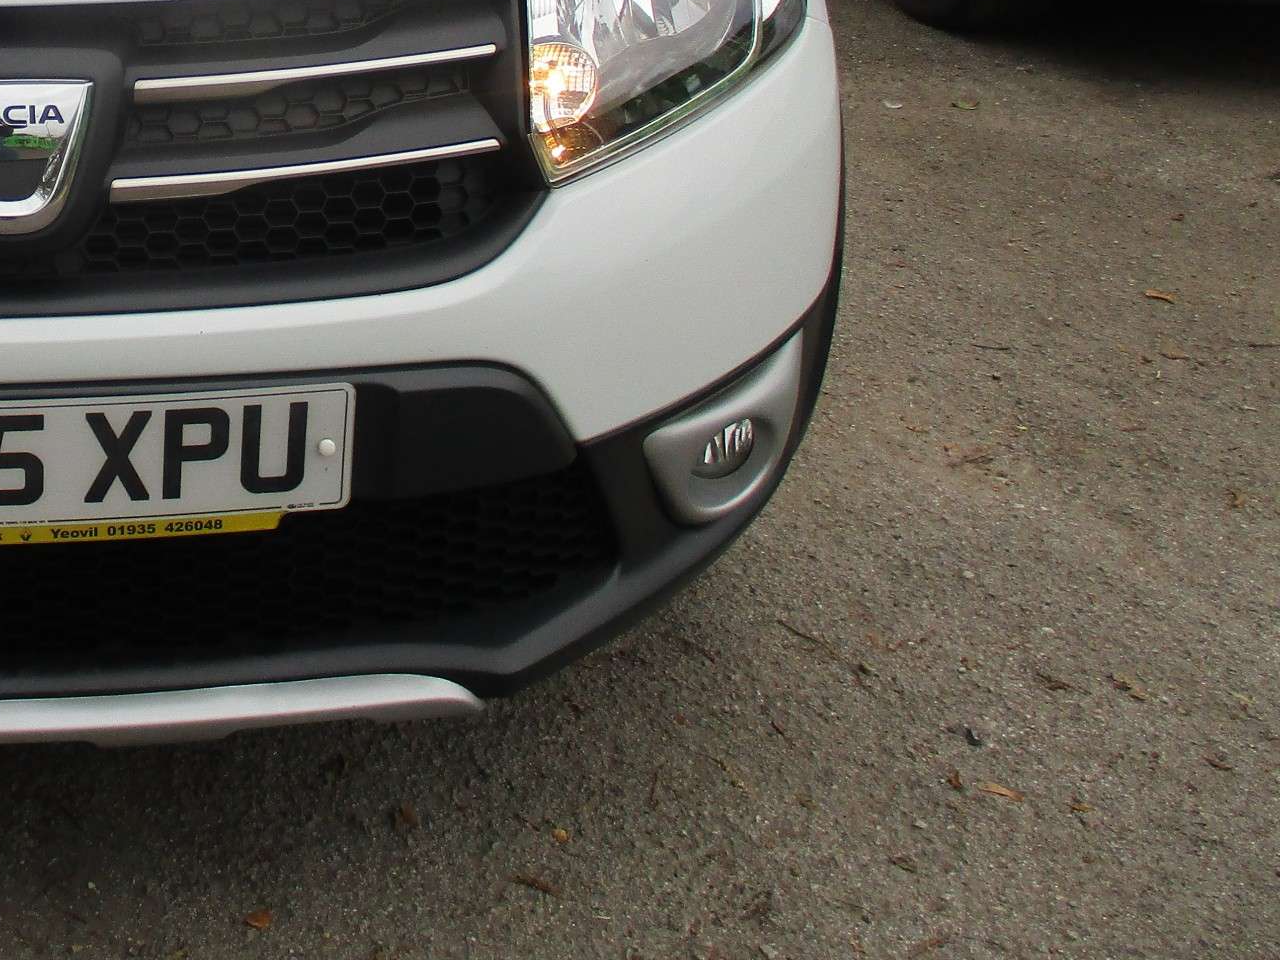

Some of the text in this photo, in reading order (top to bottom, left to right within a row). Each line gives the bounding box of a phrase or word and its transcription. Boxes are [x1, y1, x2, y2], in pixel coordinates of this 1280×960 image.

[83, 400, 310, 505] XPU
[50, 527, 98, 539] Yeovil
[107, 523, 156, 537] 01935
[164, 519, 223, 533] 426048
